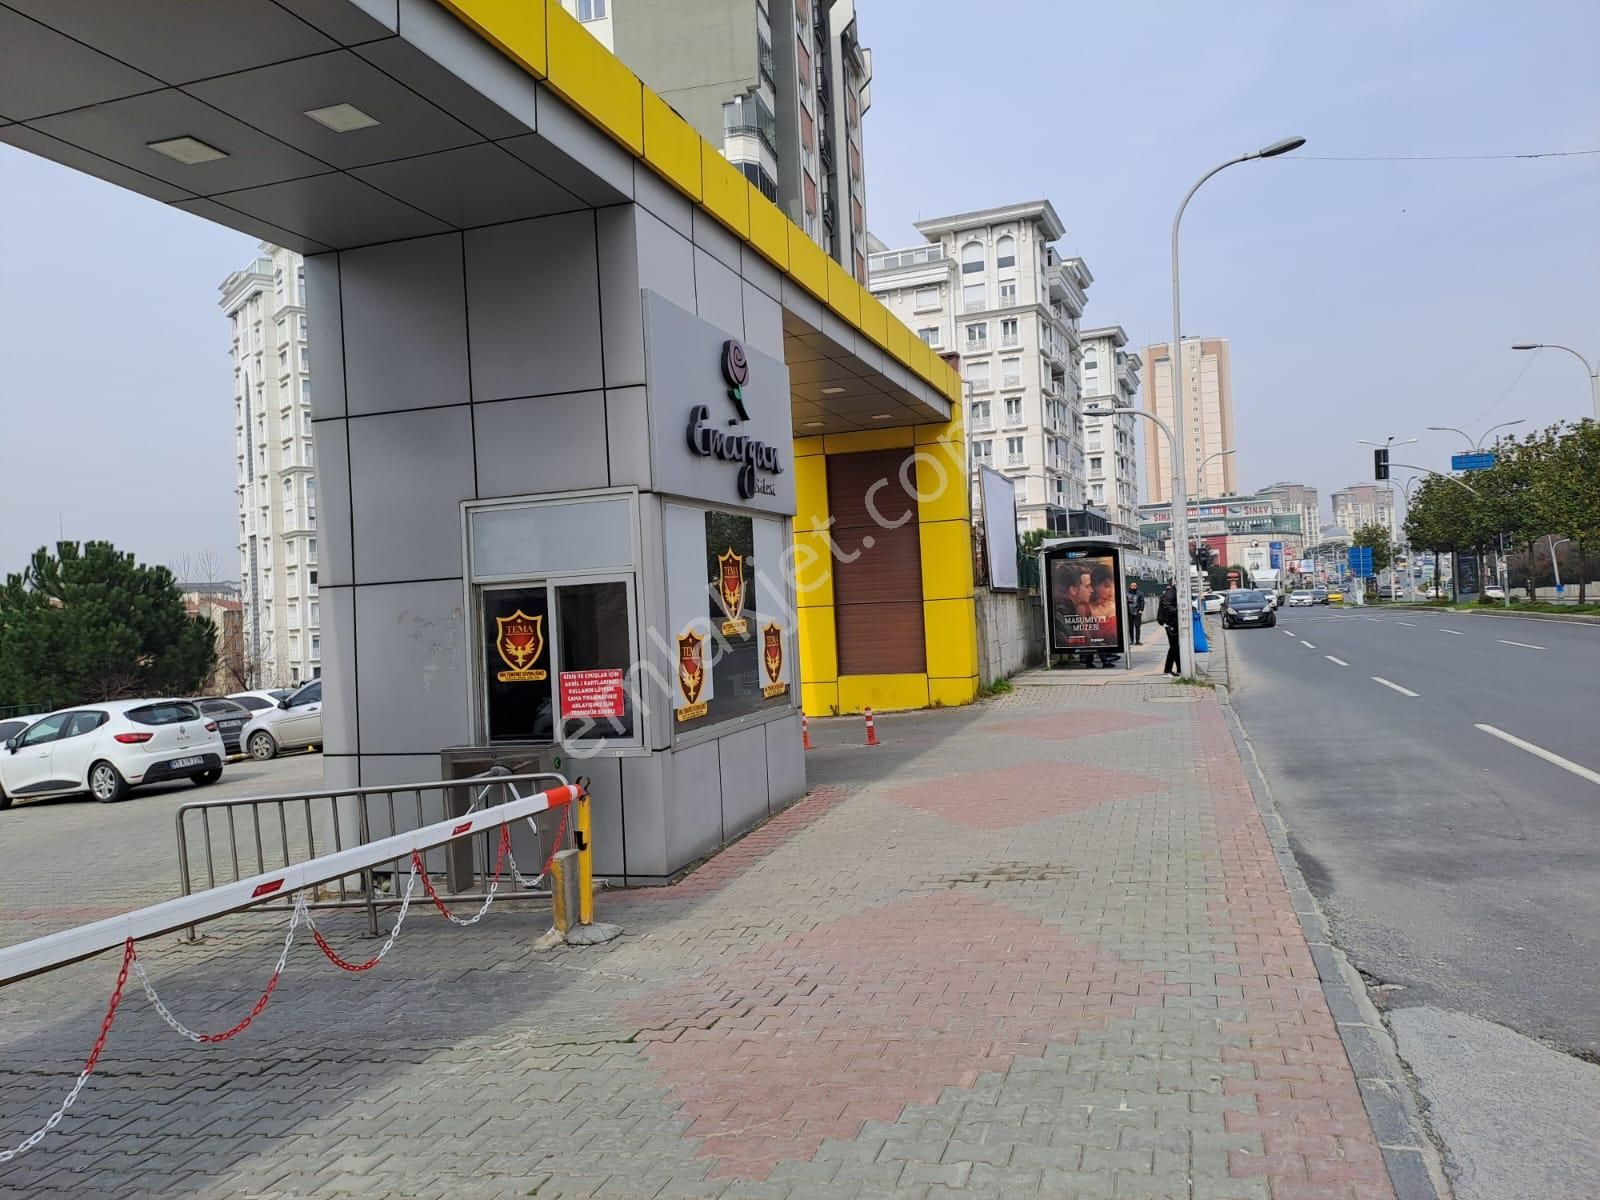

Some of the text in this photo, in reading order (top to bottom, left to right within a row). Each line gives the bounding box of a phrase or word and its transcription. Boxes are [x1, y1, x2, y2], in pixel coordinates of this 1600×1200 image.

[686, 404, 785, 499] Emirgan
[1244, 506, 1269, 515] SINAV
[1153, 513, 1171, 522] SINA
[505, 625, 534, 634] TEMA
